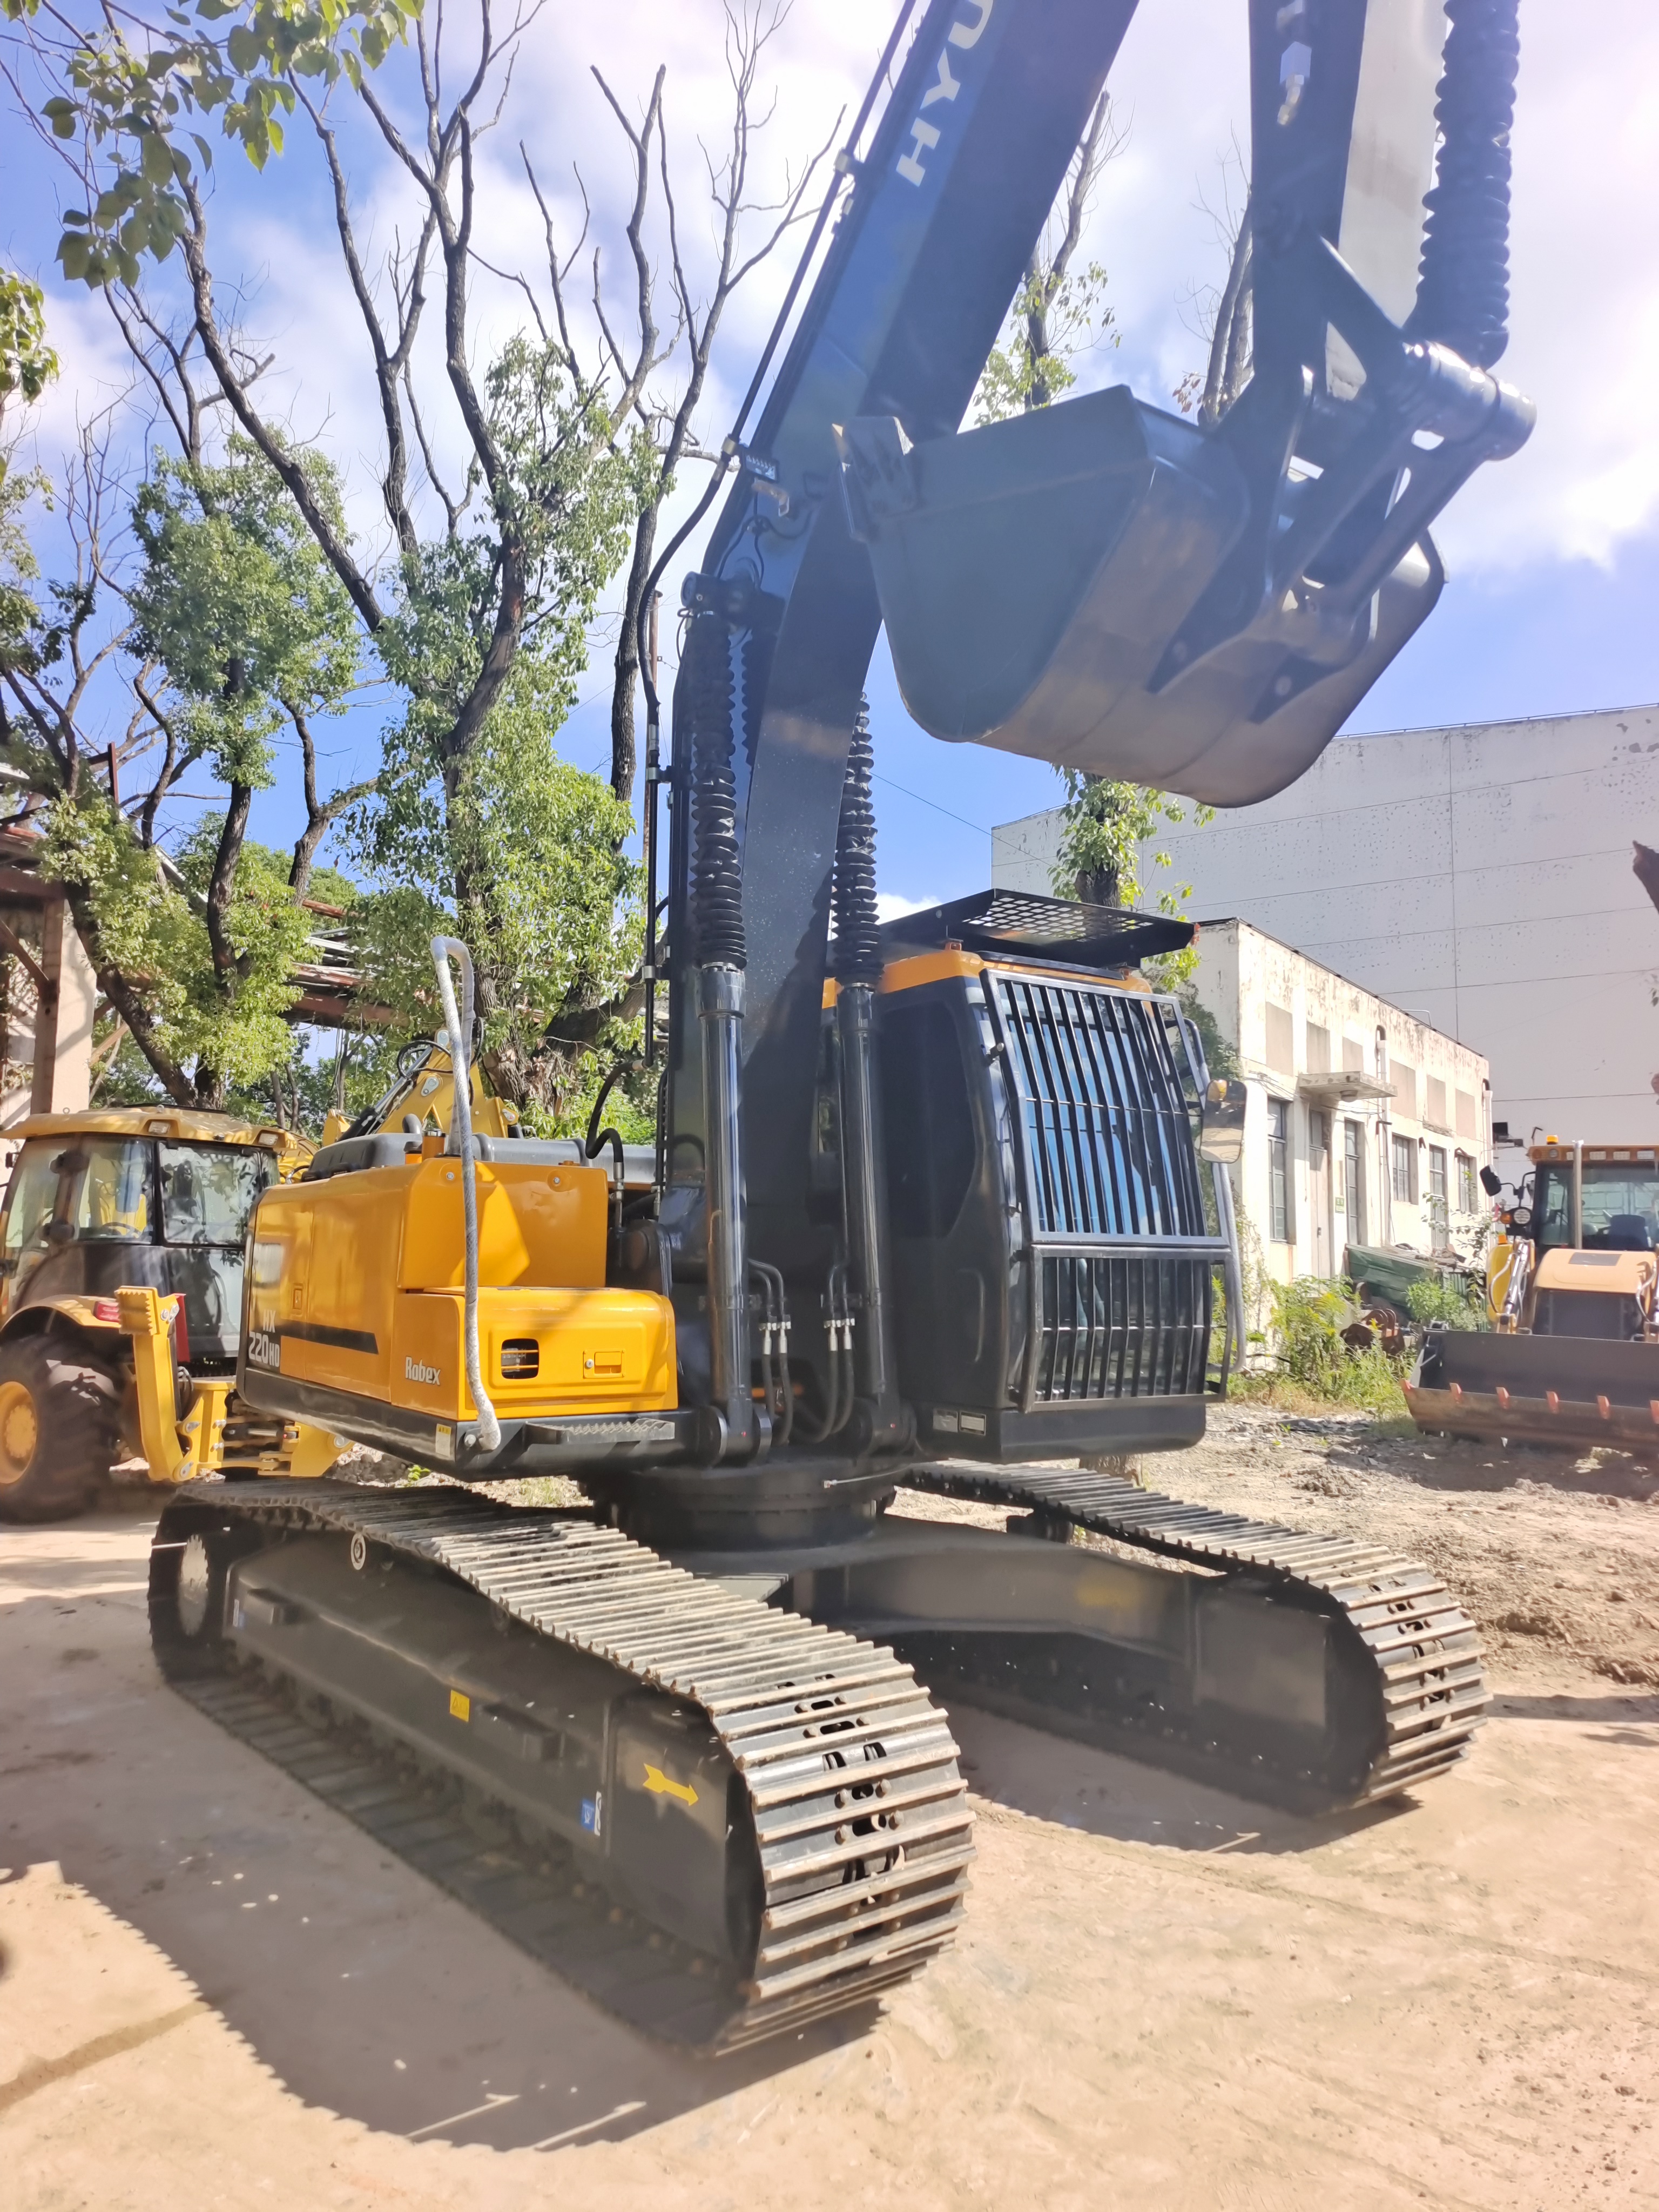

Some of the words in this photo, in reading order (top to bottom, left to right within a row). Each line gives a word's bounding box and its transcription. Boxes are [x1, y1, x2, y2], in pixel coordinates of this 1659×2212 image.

[896, 0, 994, 187] HYU
[262, 1309, 276, 1333] HX
[405, 1356, 441, 1386] Robex
